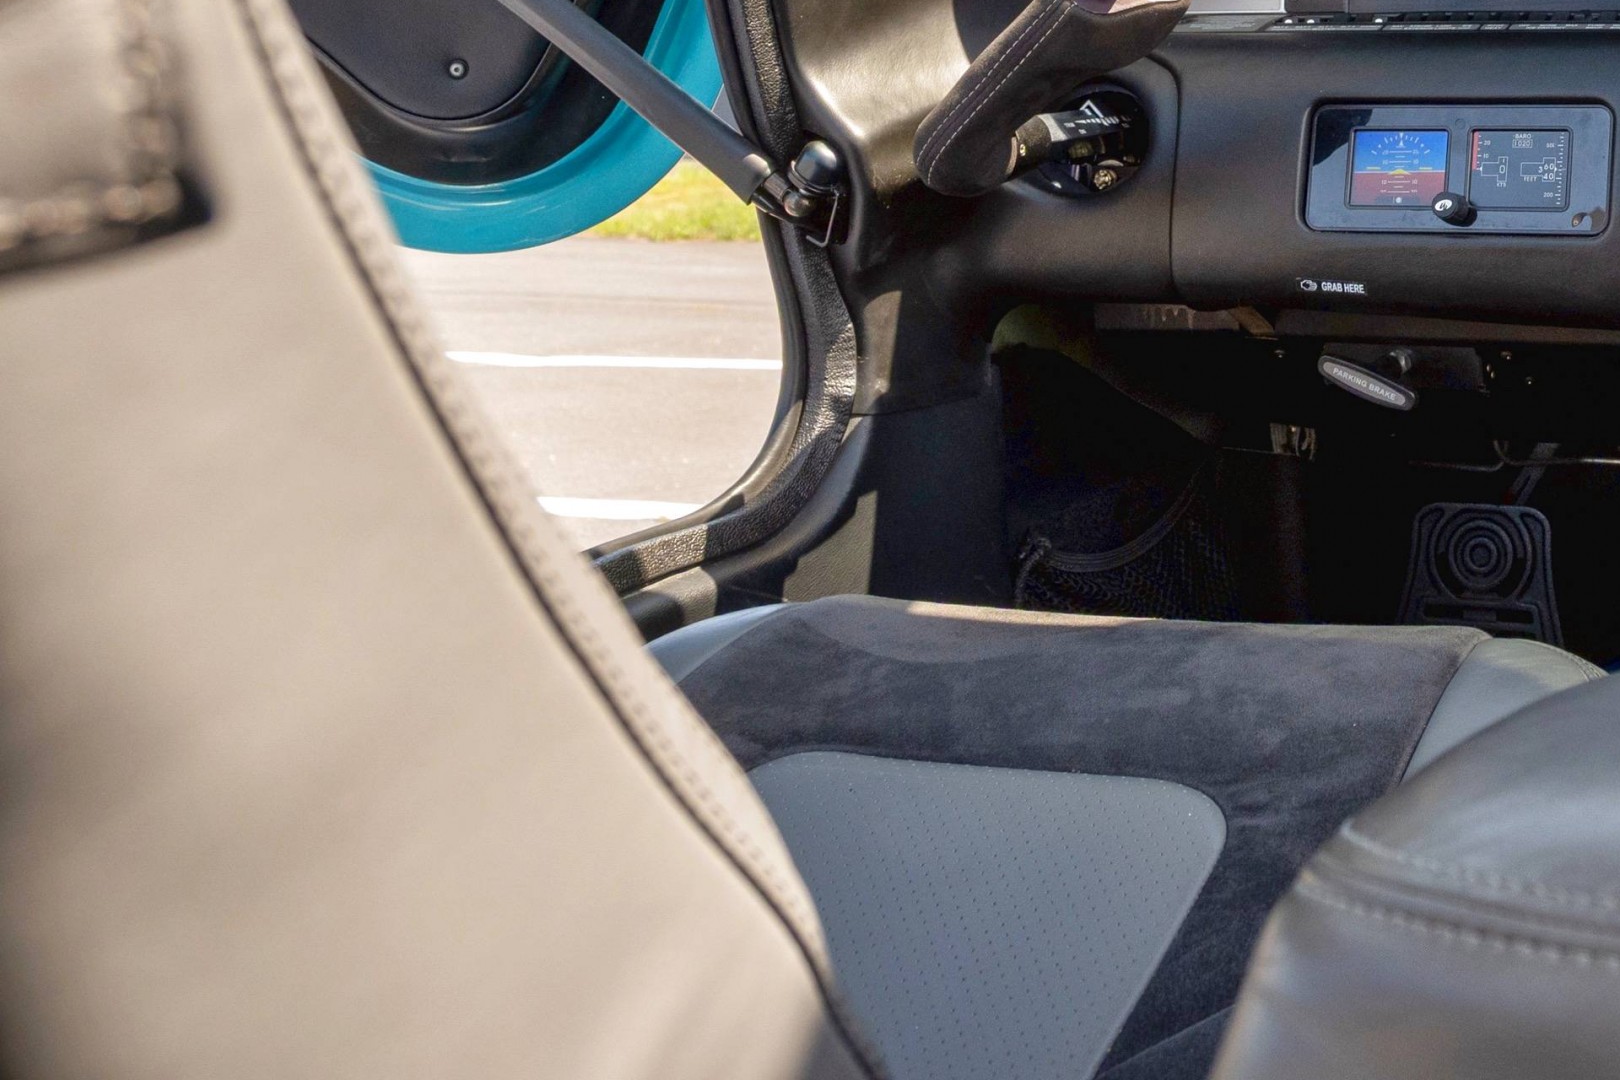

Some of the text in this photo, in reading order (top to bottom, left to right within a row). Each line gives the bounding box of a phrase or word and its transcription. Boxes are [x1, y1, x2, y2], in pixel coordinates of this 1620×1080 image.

[1321, 281, 1365, 294] GRAB HERE
[1332, 367, 1396, 401] PARKING BRAKE
